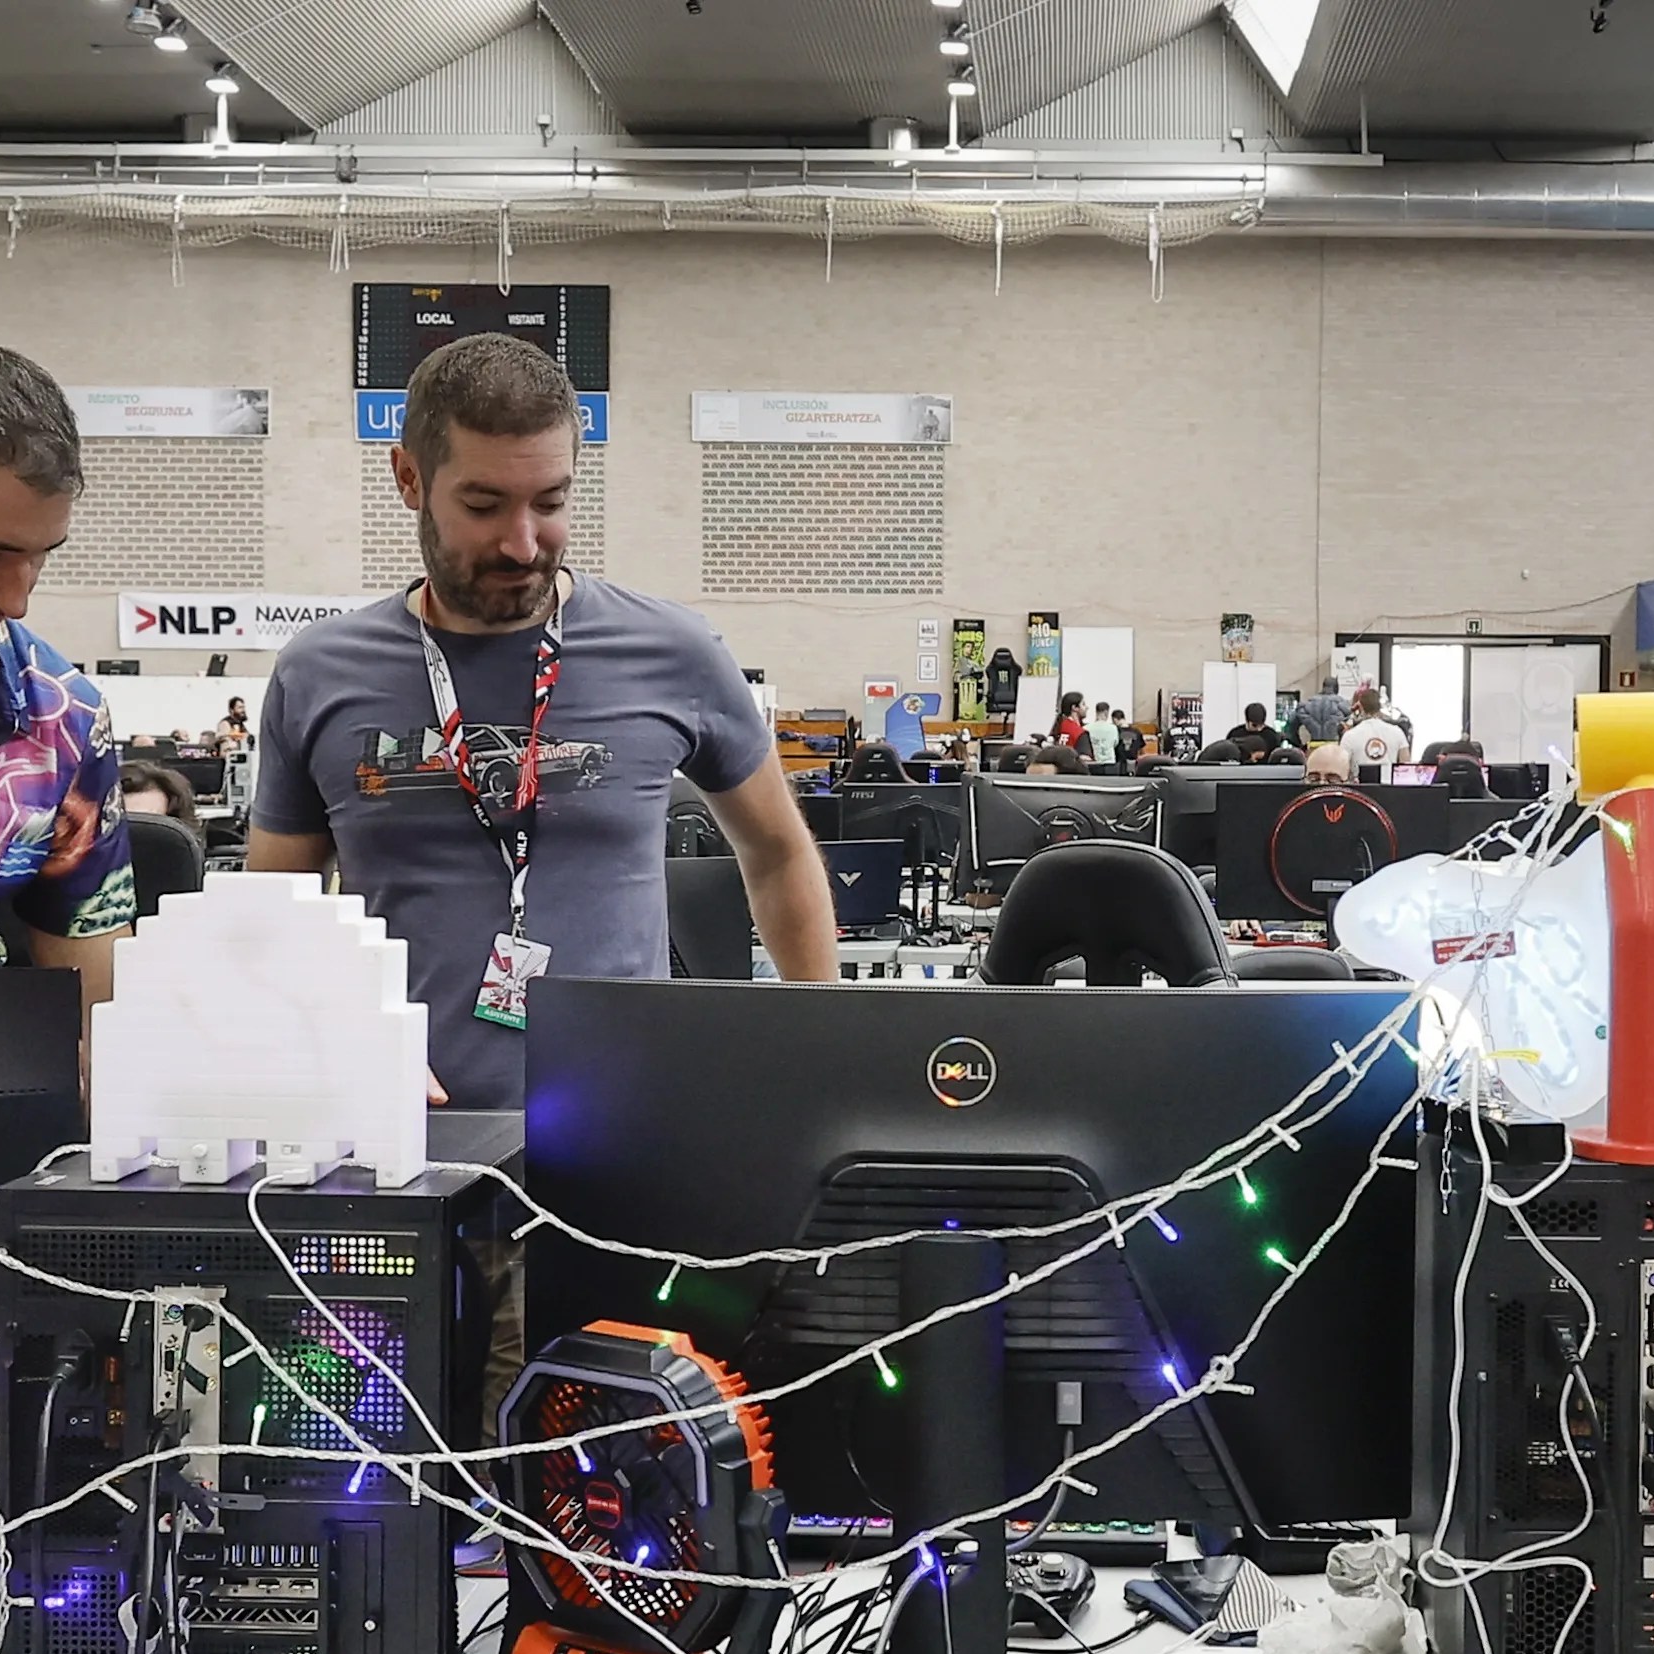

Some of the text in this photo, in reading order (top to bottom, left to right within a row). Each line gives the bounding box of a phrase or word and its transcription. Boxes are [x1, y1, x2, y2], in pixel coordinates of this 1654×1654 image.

[416, 313, 454, 325] LOCAL
[508, 314, 546, 326] VISITANTE
[786, 412, 882, 423] GIZARTERATZEA
[936, 1062, 989, 1080] DELL
